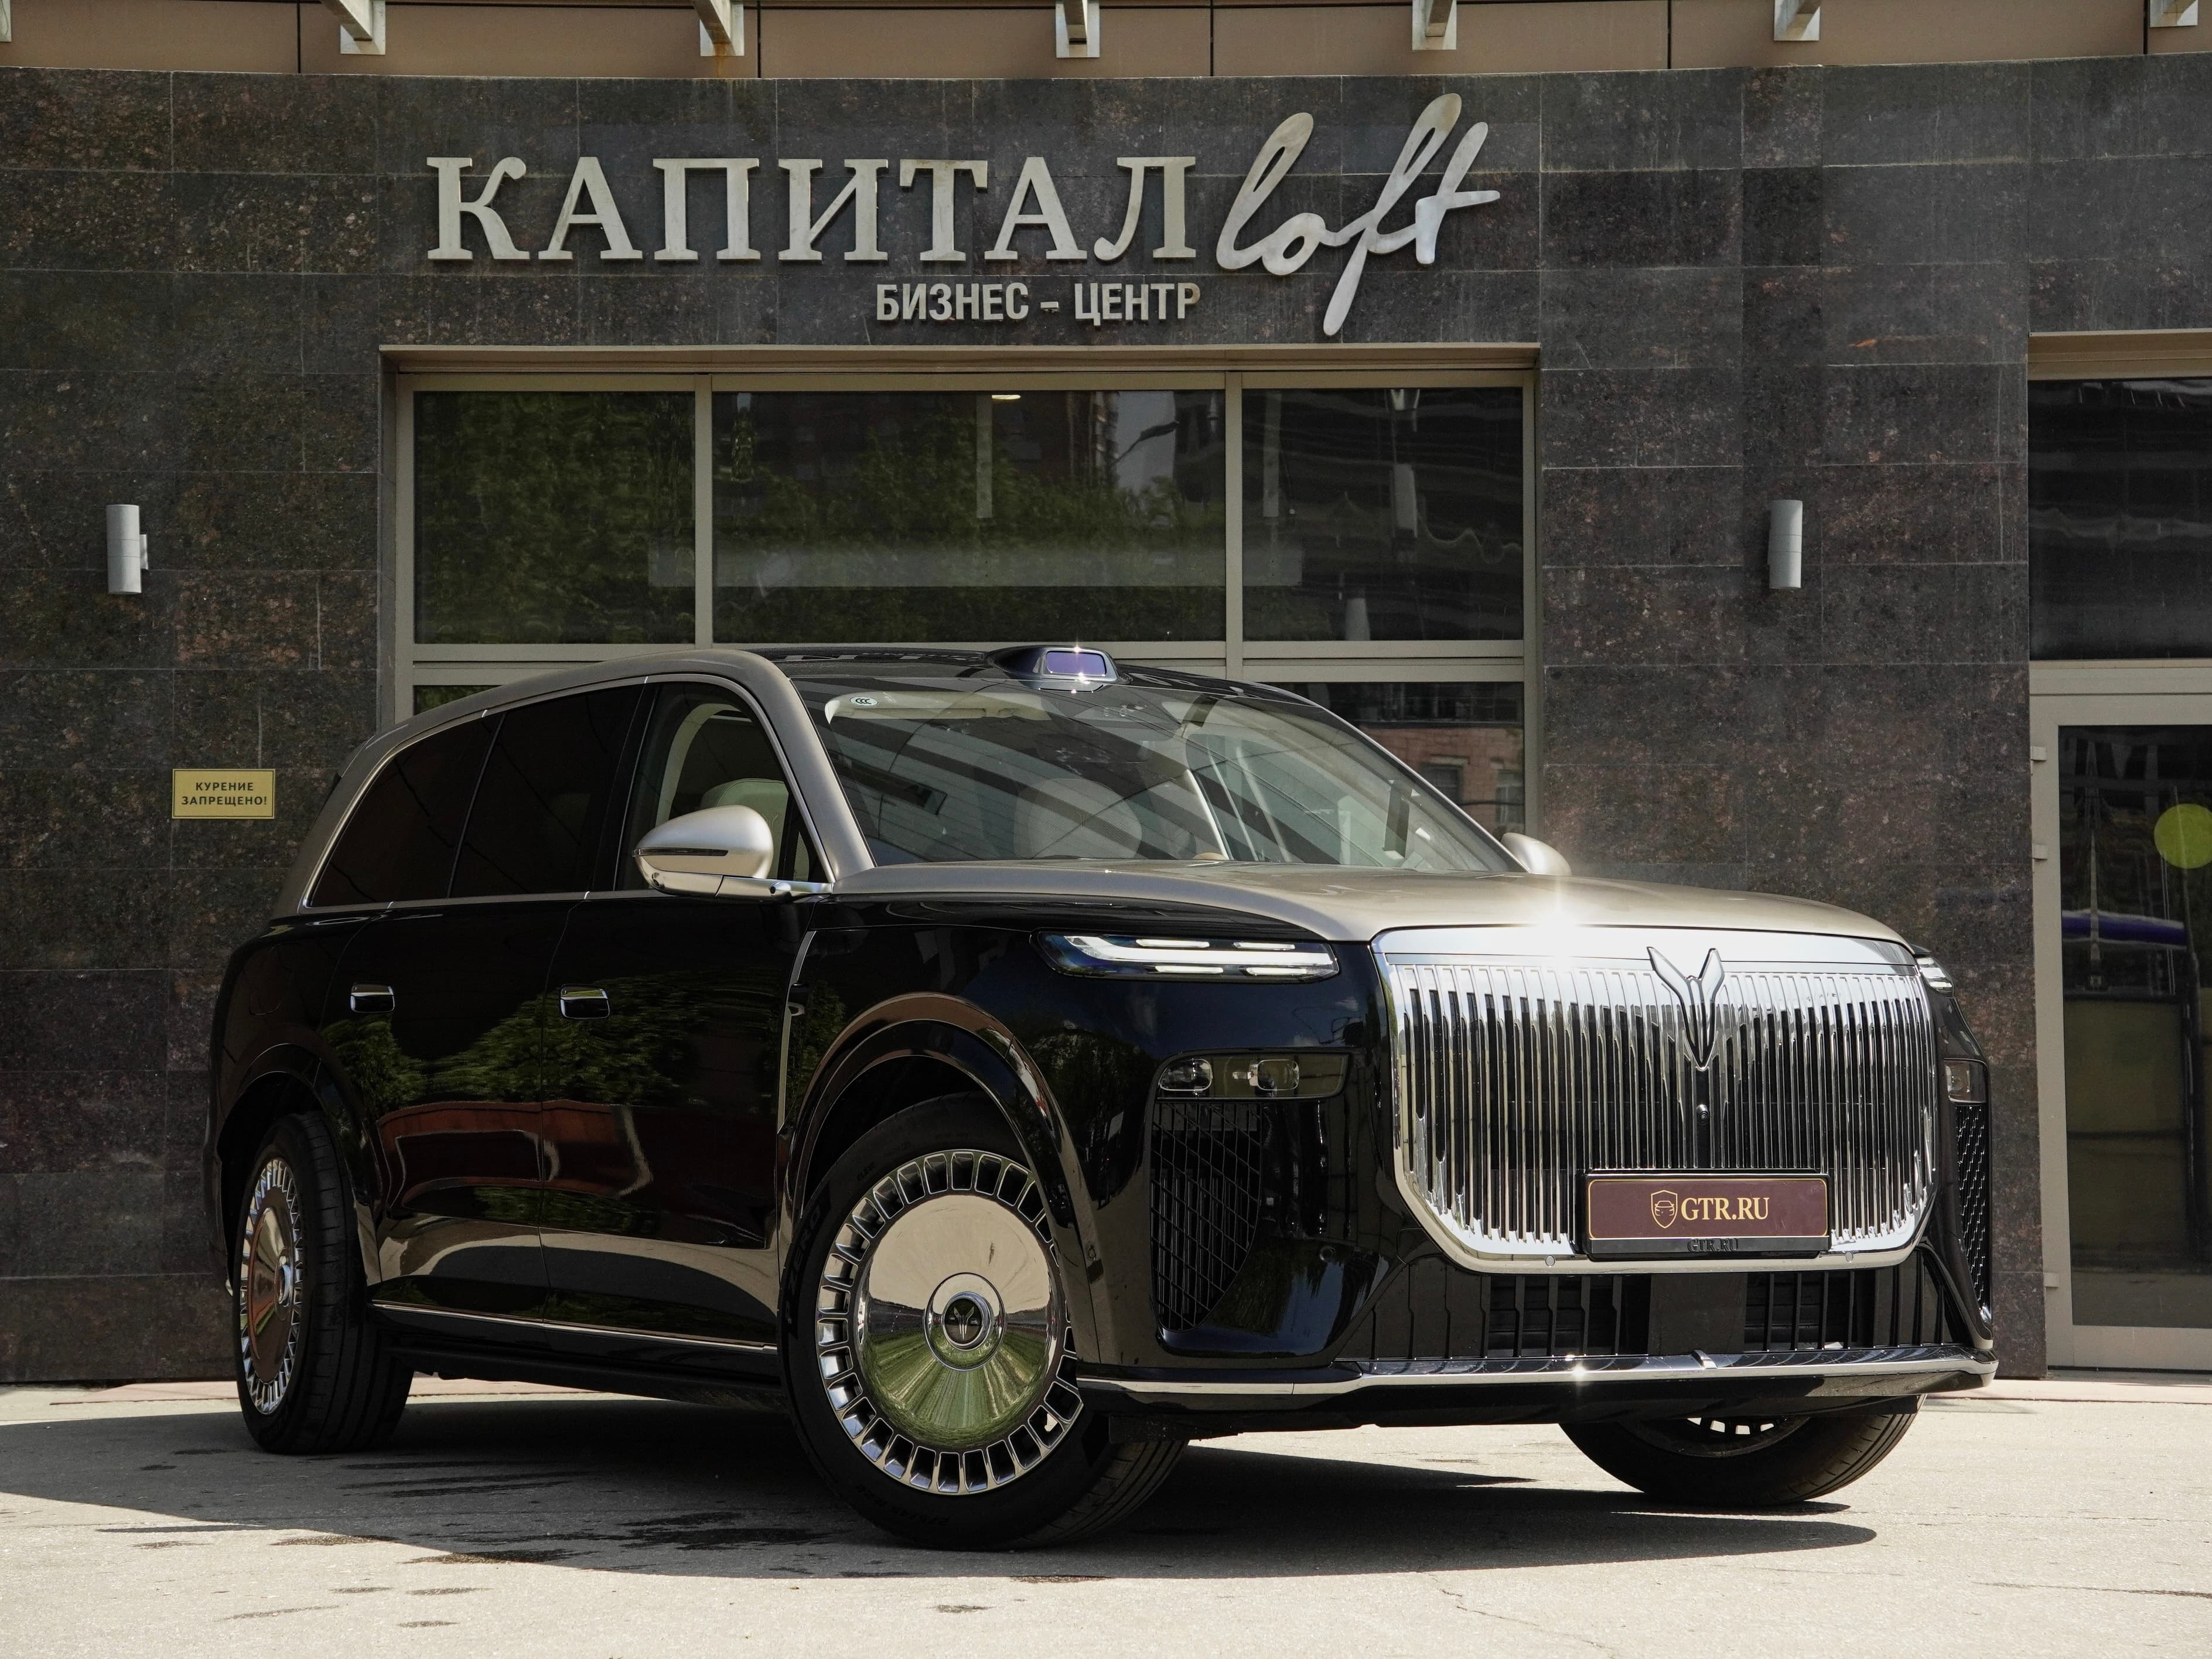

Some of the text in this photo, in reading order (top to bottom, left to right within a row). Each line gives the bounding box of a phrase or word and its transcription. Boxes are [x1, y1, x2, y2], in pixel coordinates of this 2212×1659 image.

[426, 93, 1501, 337] КАПИТАЛ loft
[876, 282, 1029, 322] БИЗНЕС
[1074, 282, 1201, 326] ЦЕНТР
[195, 782, 254, 791] КУРЕНИЕ
[181, 796, 267, 807] ЗАПРЕЩЕНО!
[1681, 1197, 1770, 1221] GTR.RU
[1687, 1237, 1739, 1252] GTR.RU
